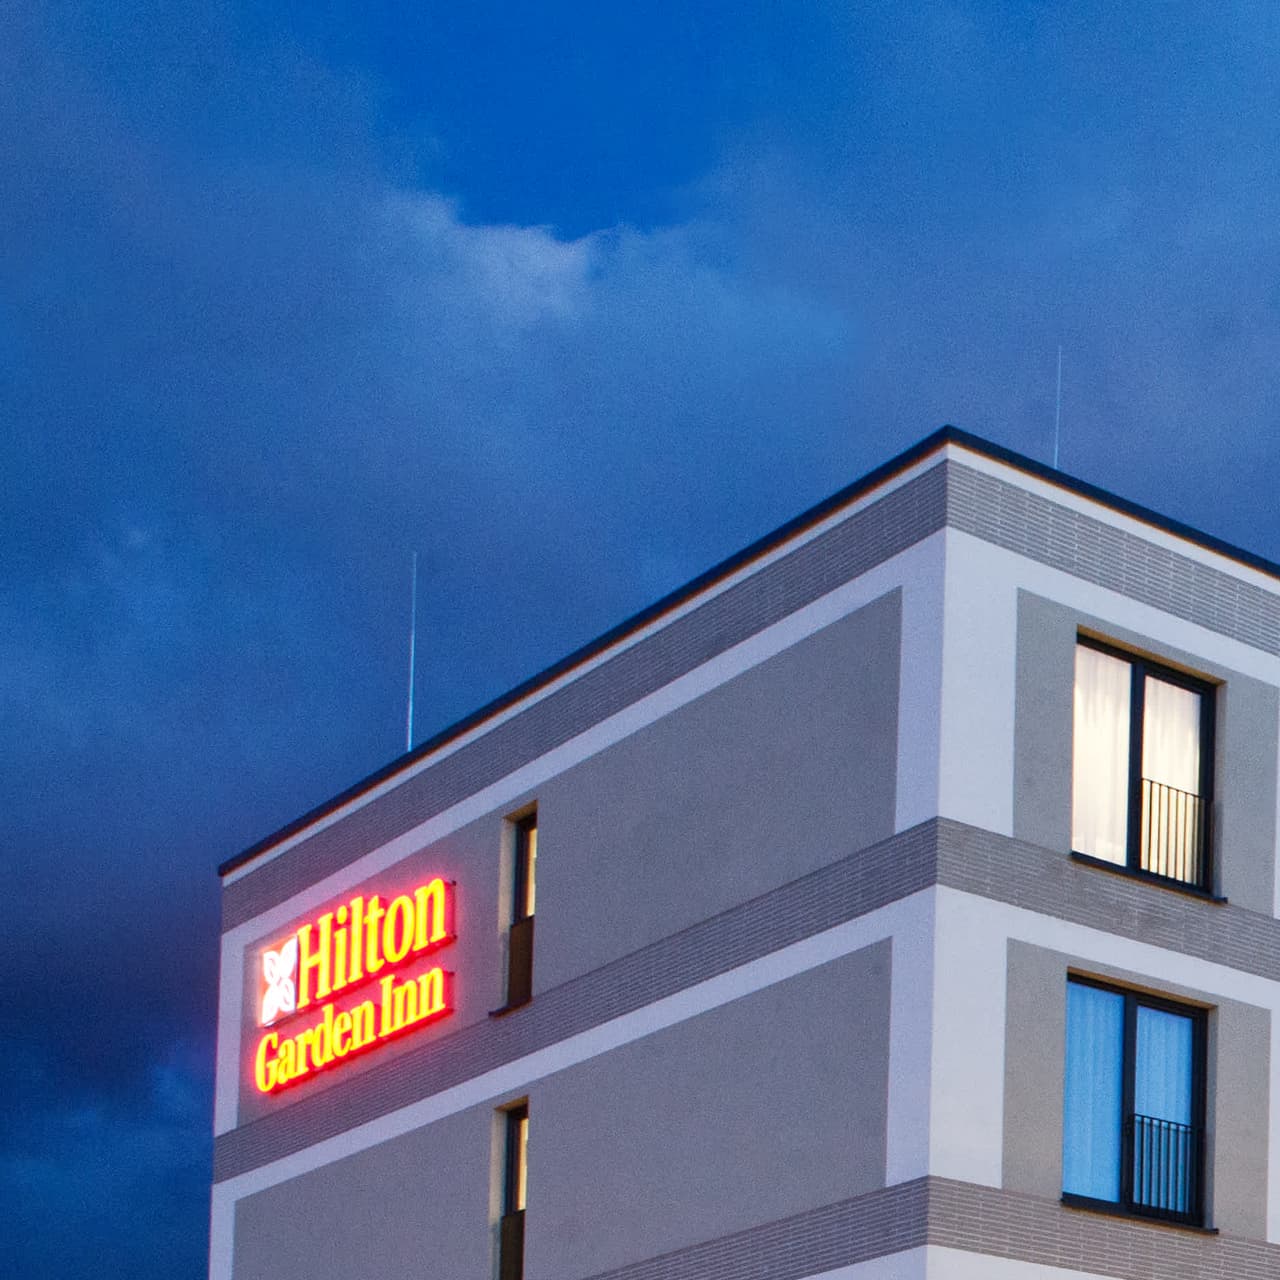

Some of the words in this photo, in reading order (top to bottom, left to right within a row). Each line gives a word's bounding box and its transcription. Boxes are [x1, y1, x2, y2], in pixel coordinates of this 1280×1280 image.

[296, 877, 447, 1010] Hilton
[254, 998, 377, 1093] Garden
[378, 966, 446, 1038] Inn
